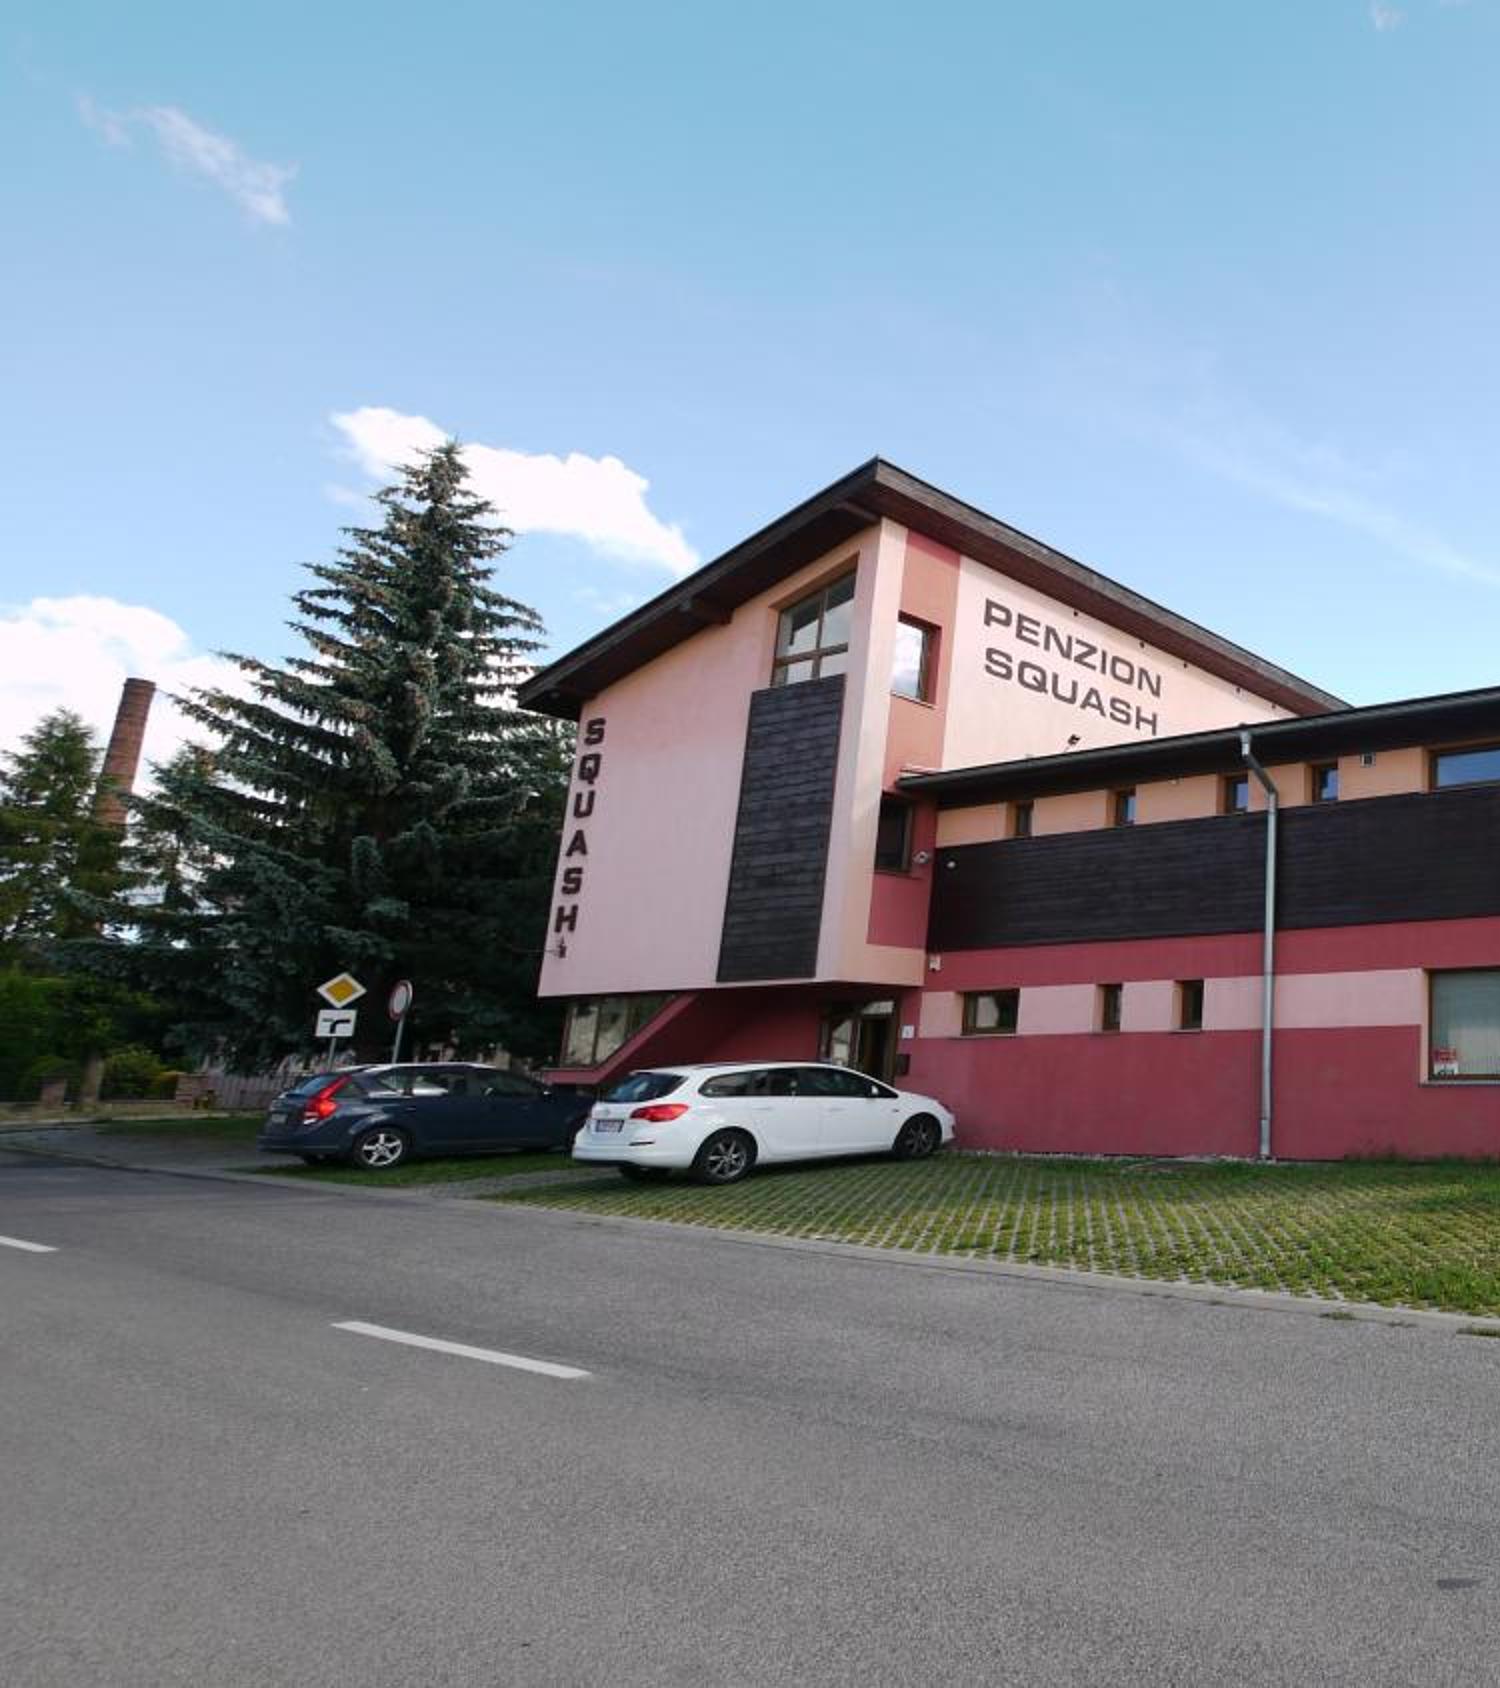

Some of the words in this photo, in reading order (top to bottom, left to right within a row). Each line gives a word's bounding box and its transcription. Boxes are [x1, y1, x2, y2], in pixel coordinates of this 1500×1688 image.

[983, 597, 1162, 698] PENZION
[984, 647, 1158, 736] SQUASH
[554, 717, 607, 933] SQUASH
